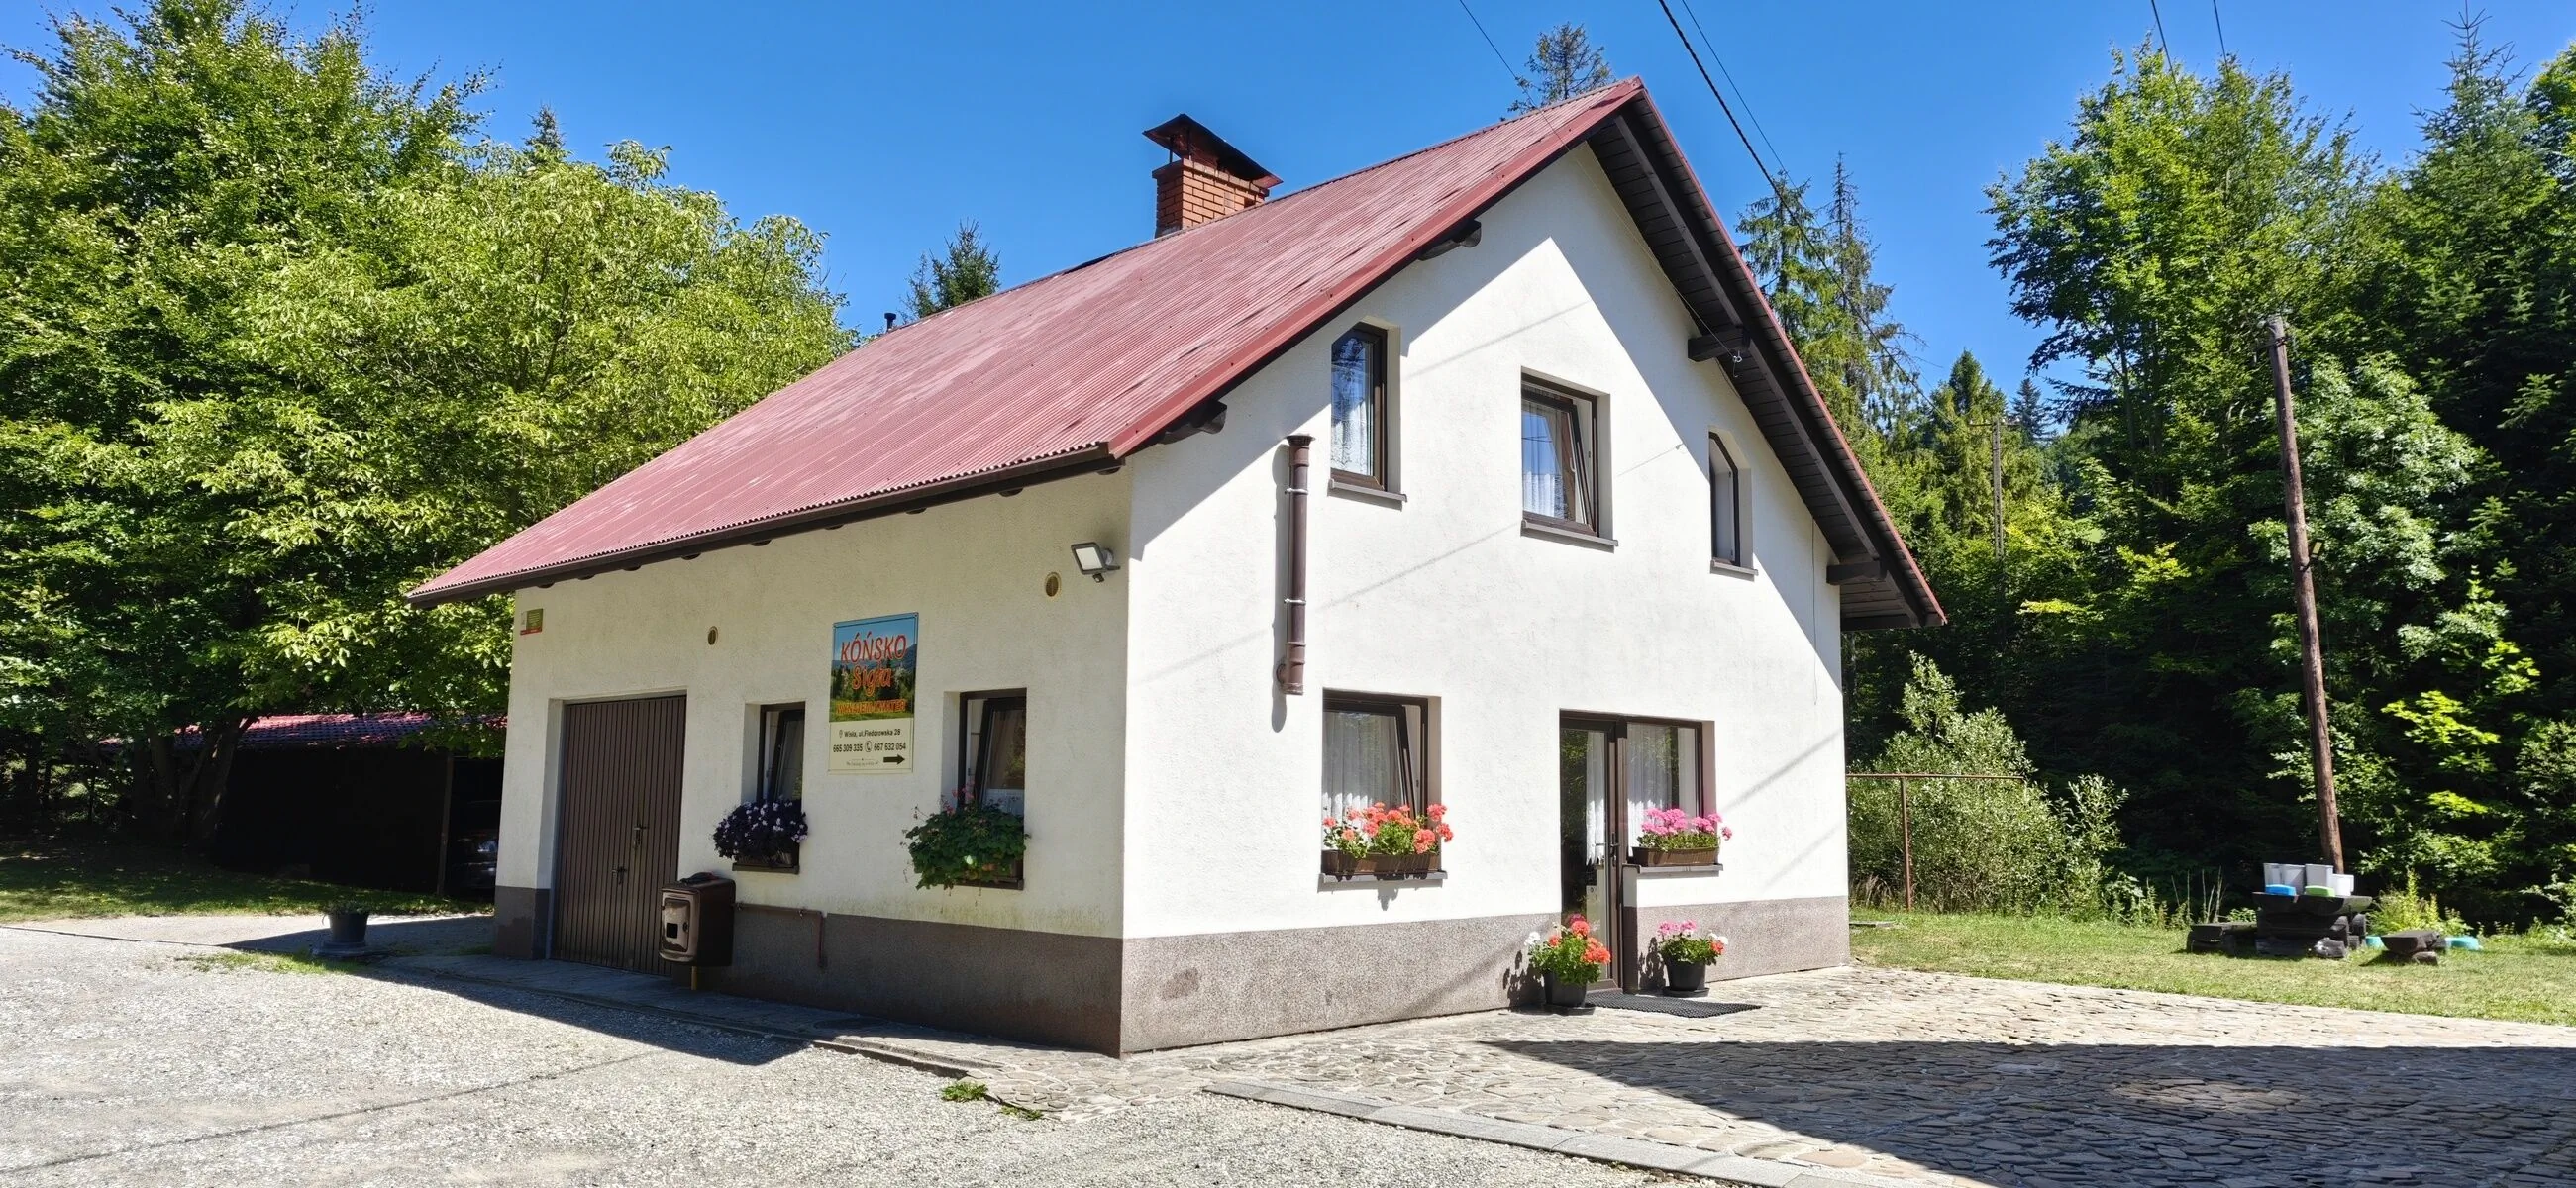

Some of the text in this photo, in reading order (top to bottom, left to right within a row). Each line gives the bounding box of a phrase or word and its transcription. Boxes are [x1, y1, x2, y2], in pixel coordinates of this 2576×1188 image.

[841, 631, 906, 663] KÓŃSKO
[853, 743, 863, 752] 335
[874, 742, 883, 751] 667
[884, 742, 894, 751] 632
[895, 742, 906, 751] 054
